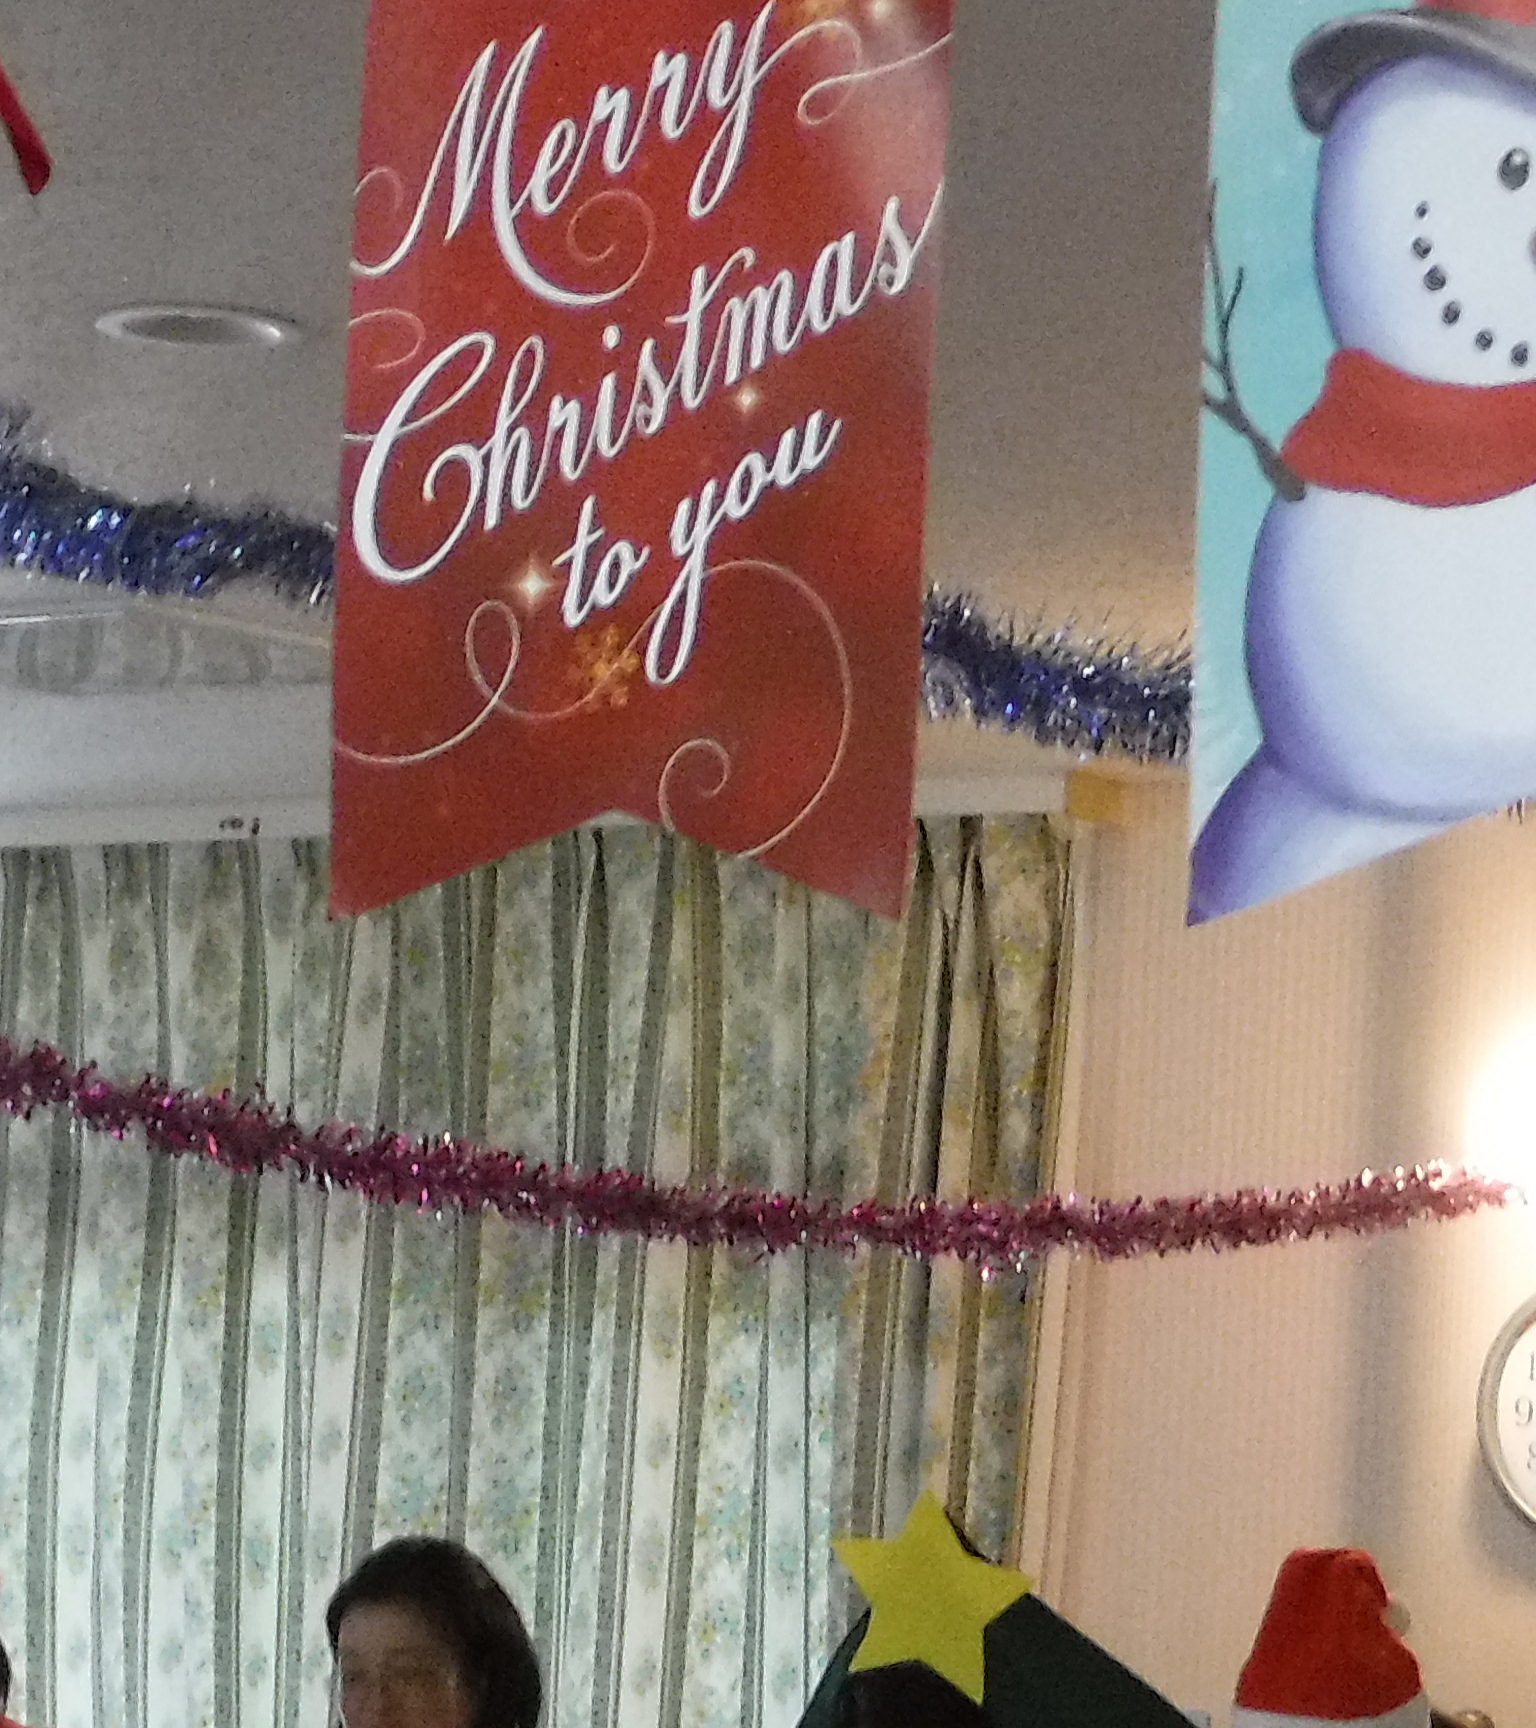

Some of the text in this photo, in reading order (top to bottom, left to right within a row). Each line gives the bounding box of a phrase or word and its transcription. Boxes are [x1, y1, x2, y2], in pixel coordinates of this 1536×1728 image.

[350, 0, 774, 306] Merry
[344, 180, 946, 586] Christmas
[552, 408, 844, 686] to you
[1514, 1398, 1535, 1427] 9
